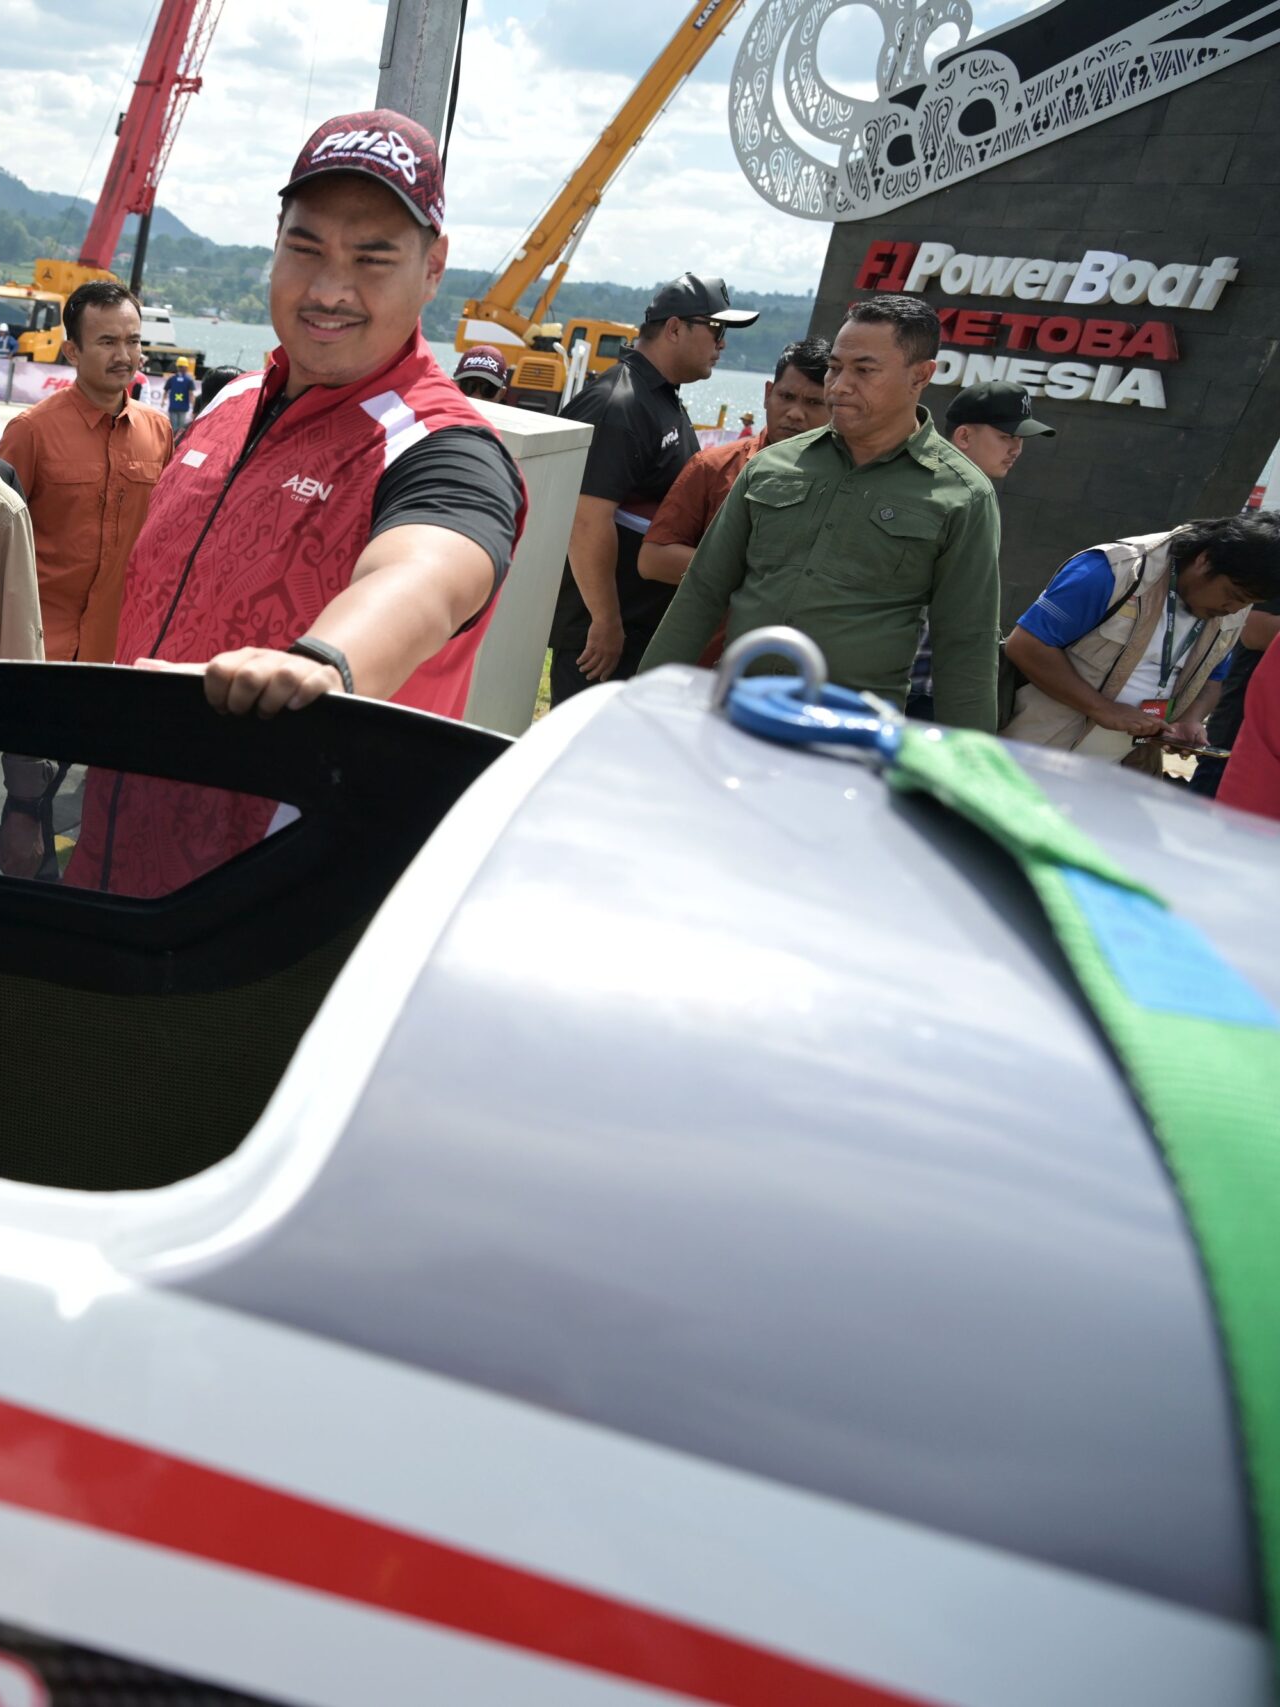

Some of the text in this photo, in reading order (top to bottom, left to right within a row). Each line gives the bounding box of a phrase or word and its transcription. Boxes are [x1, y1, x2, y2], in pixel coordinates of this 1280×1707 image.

[328, 151, 351, 159] WORLD
[936, 307, 1179, 361] KETOBA
[929, 349, 1167, 410] ONESIA
